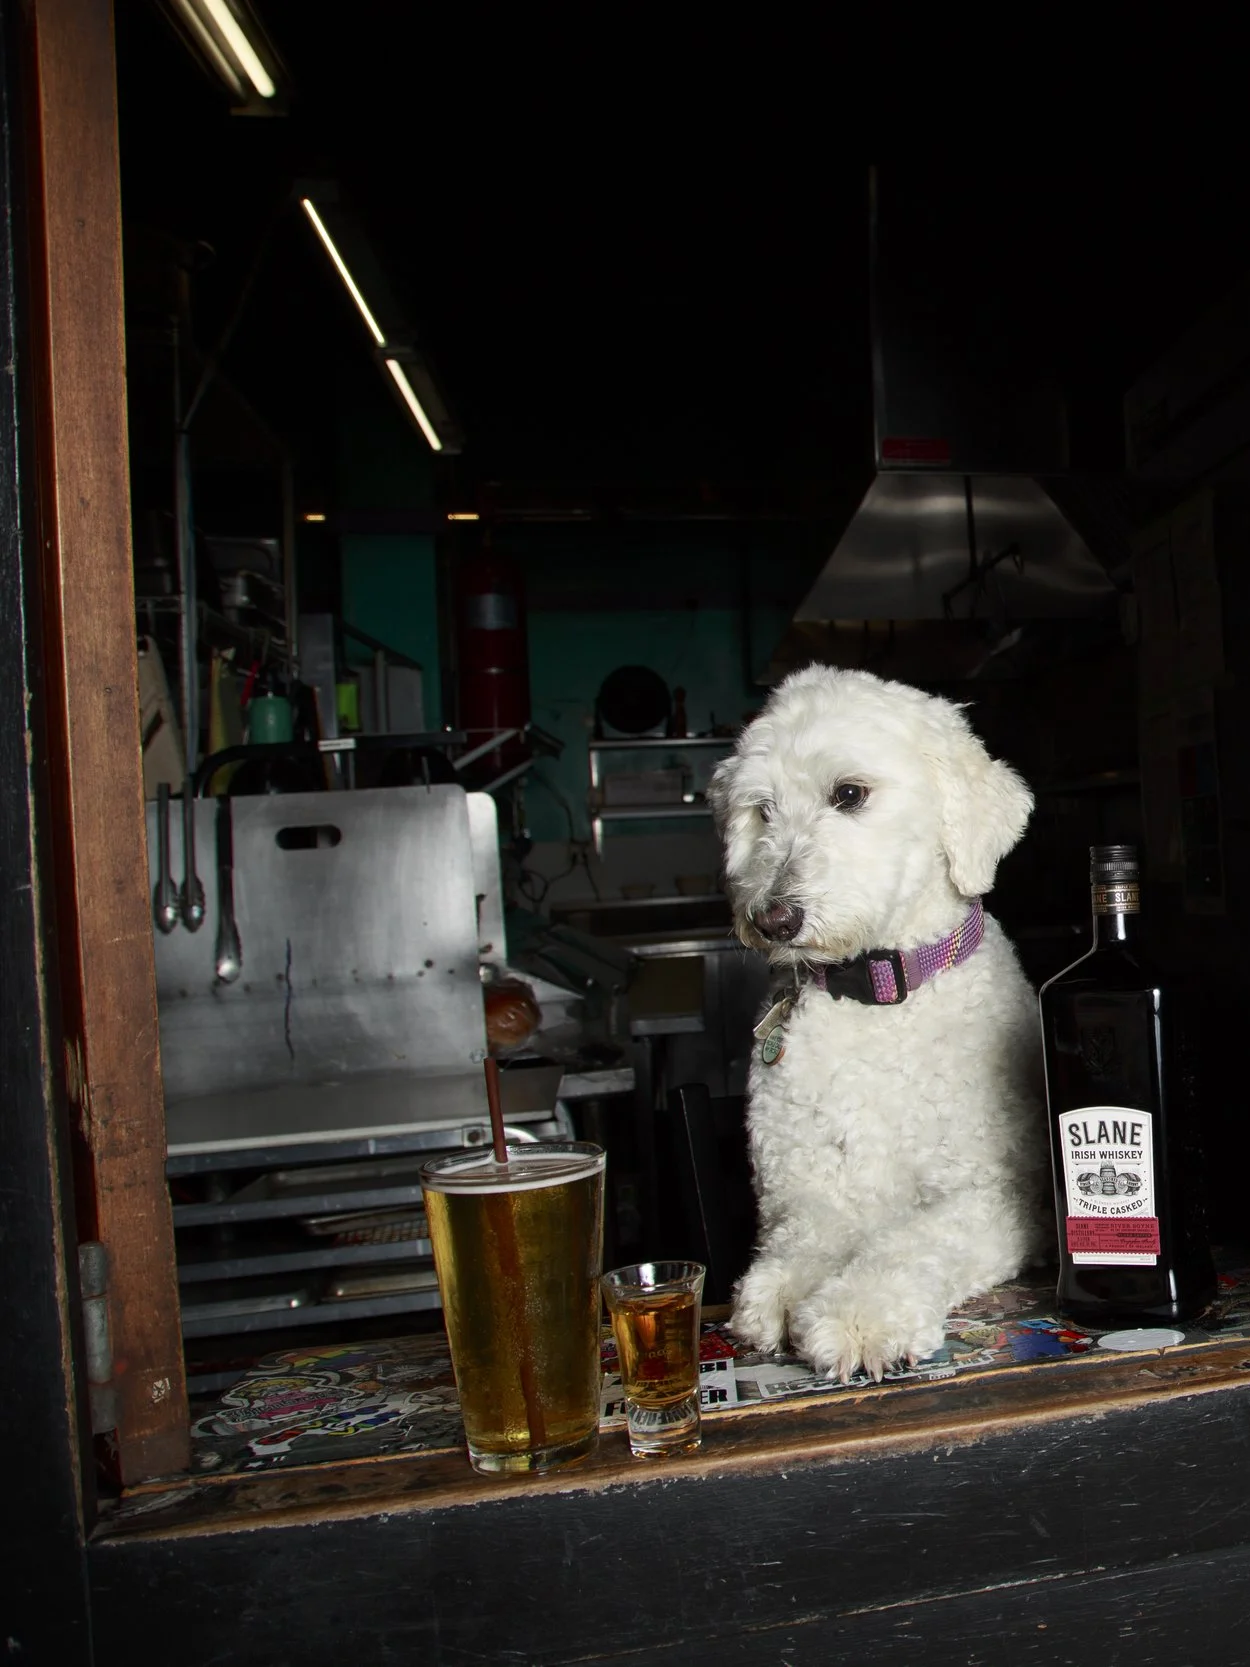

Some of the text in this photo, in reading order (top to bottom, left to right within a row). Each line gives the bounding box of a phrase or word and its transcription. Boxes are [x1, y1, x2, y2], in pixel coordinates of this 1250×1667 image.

[1068, 1120, 1144, 1148] SLANE
[1071, 1150, 1144, 1160] IRISH WHISKEY
[1078, 1197, 1144, 1216] TRIPLE CASKED
